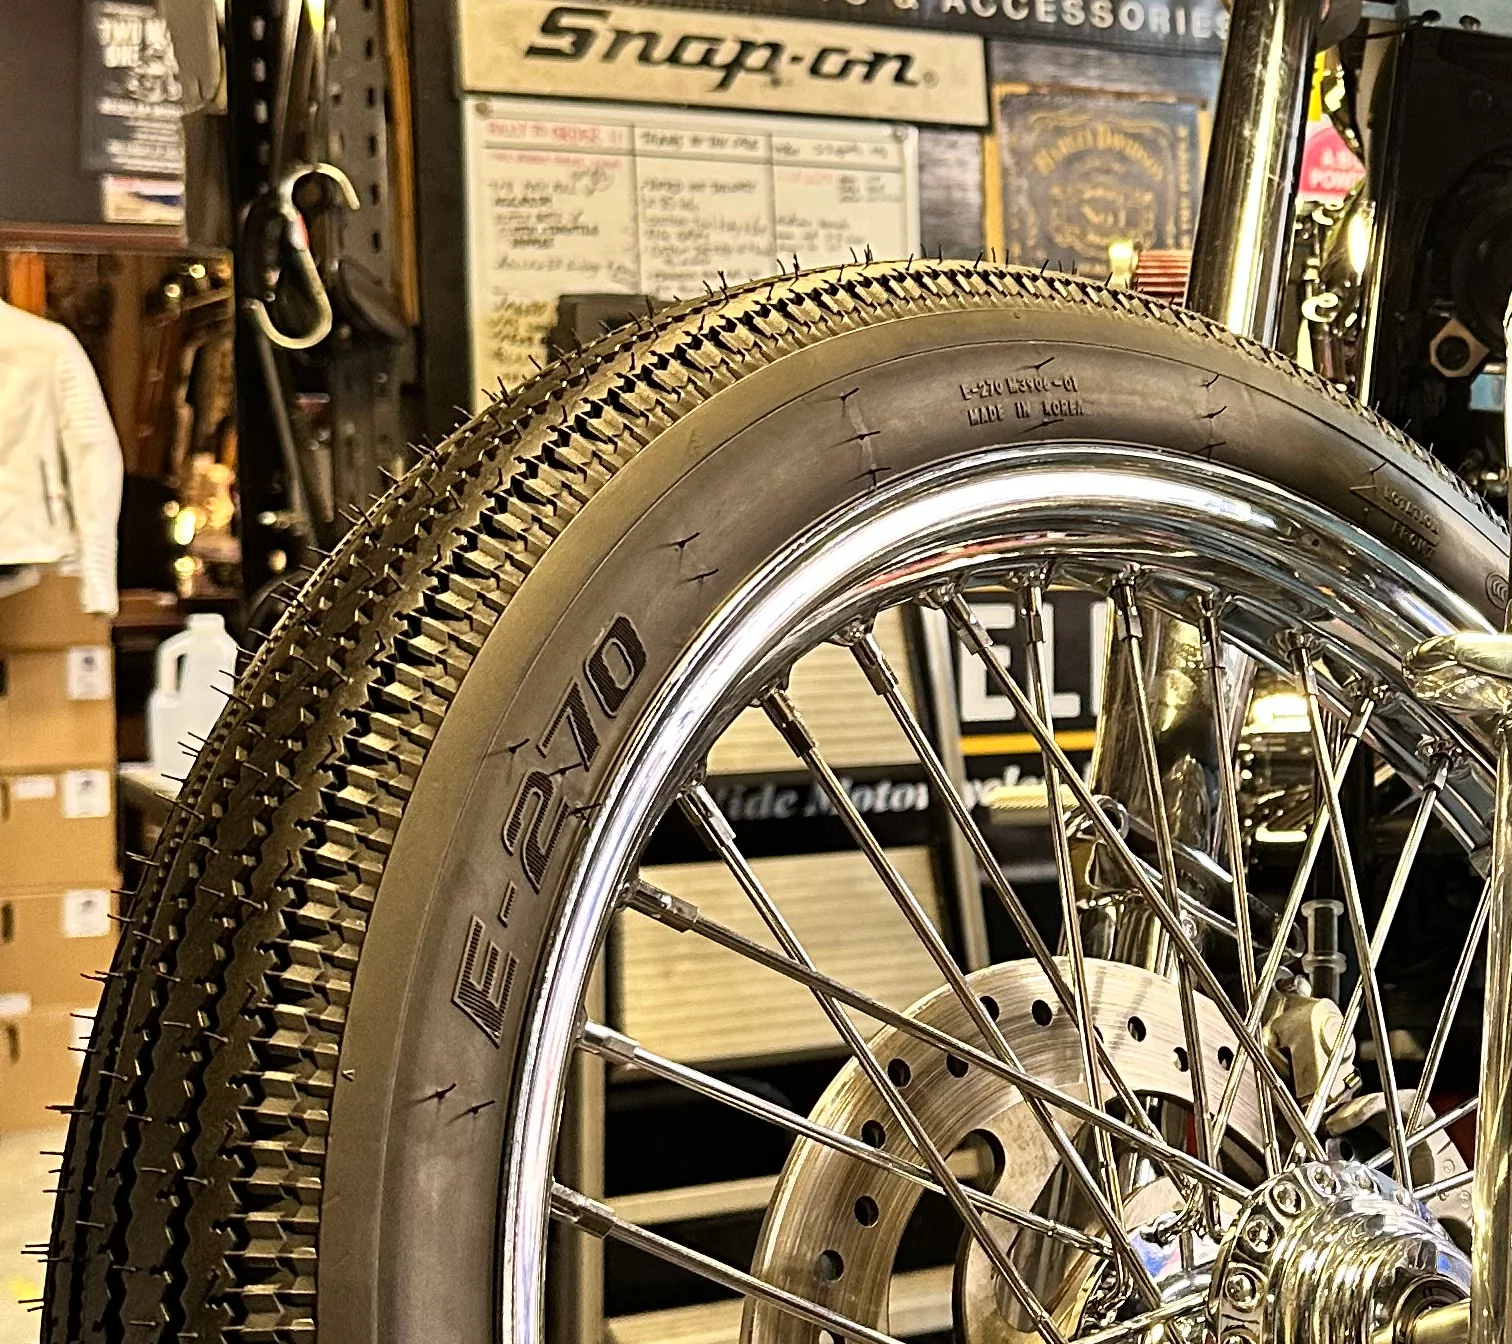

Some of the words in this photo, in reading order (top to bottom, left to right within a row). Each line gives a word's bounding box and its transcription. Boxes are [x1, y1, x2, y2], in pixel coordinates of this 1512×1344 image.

[522, 7, 921, 92] Snap-on
[967, 403, 1004, 427] MADE
[1014, 401, 1031, 420] IN
[1041, 399, 1084, 418] KOREA
[452, 611, 648, 1049] E-270
